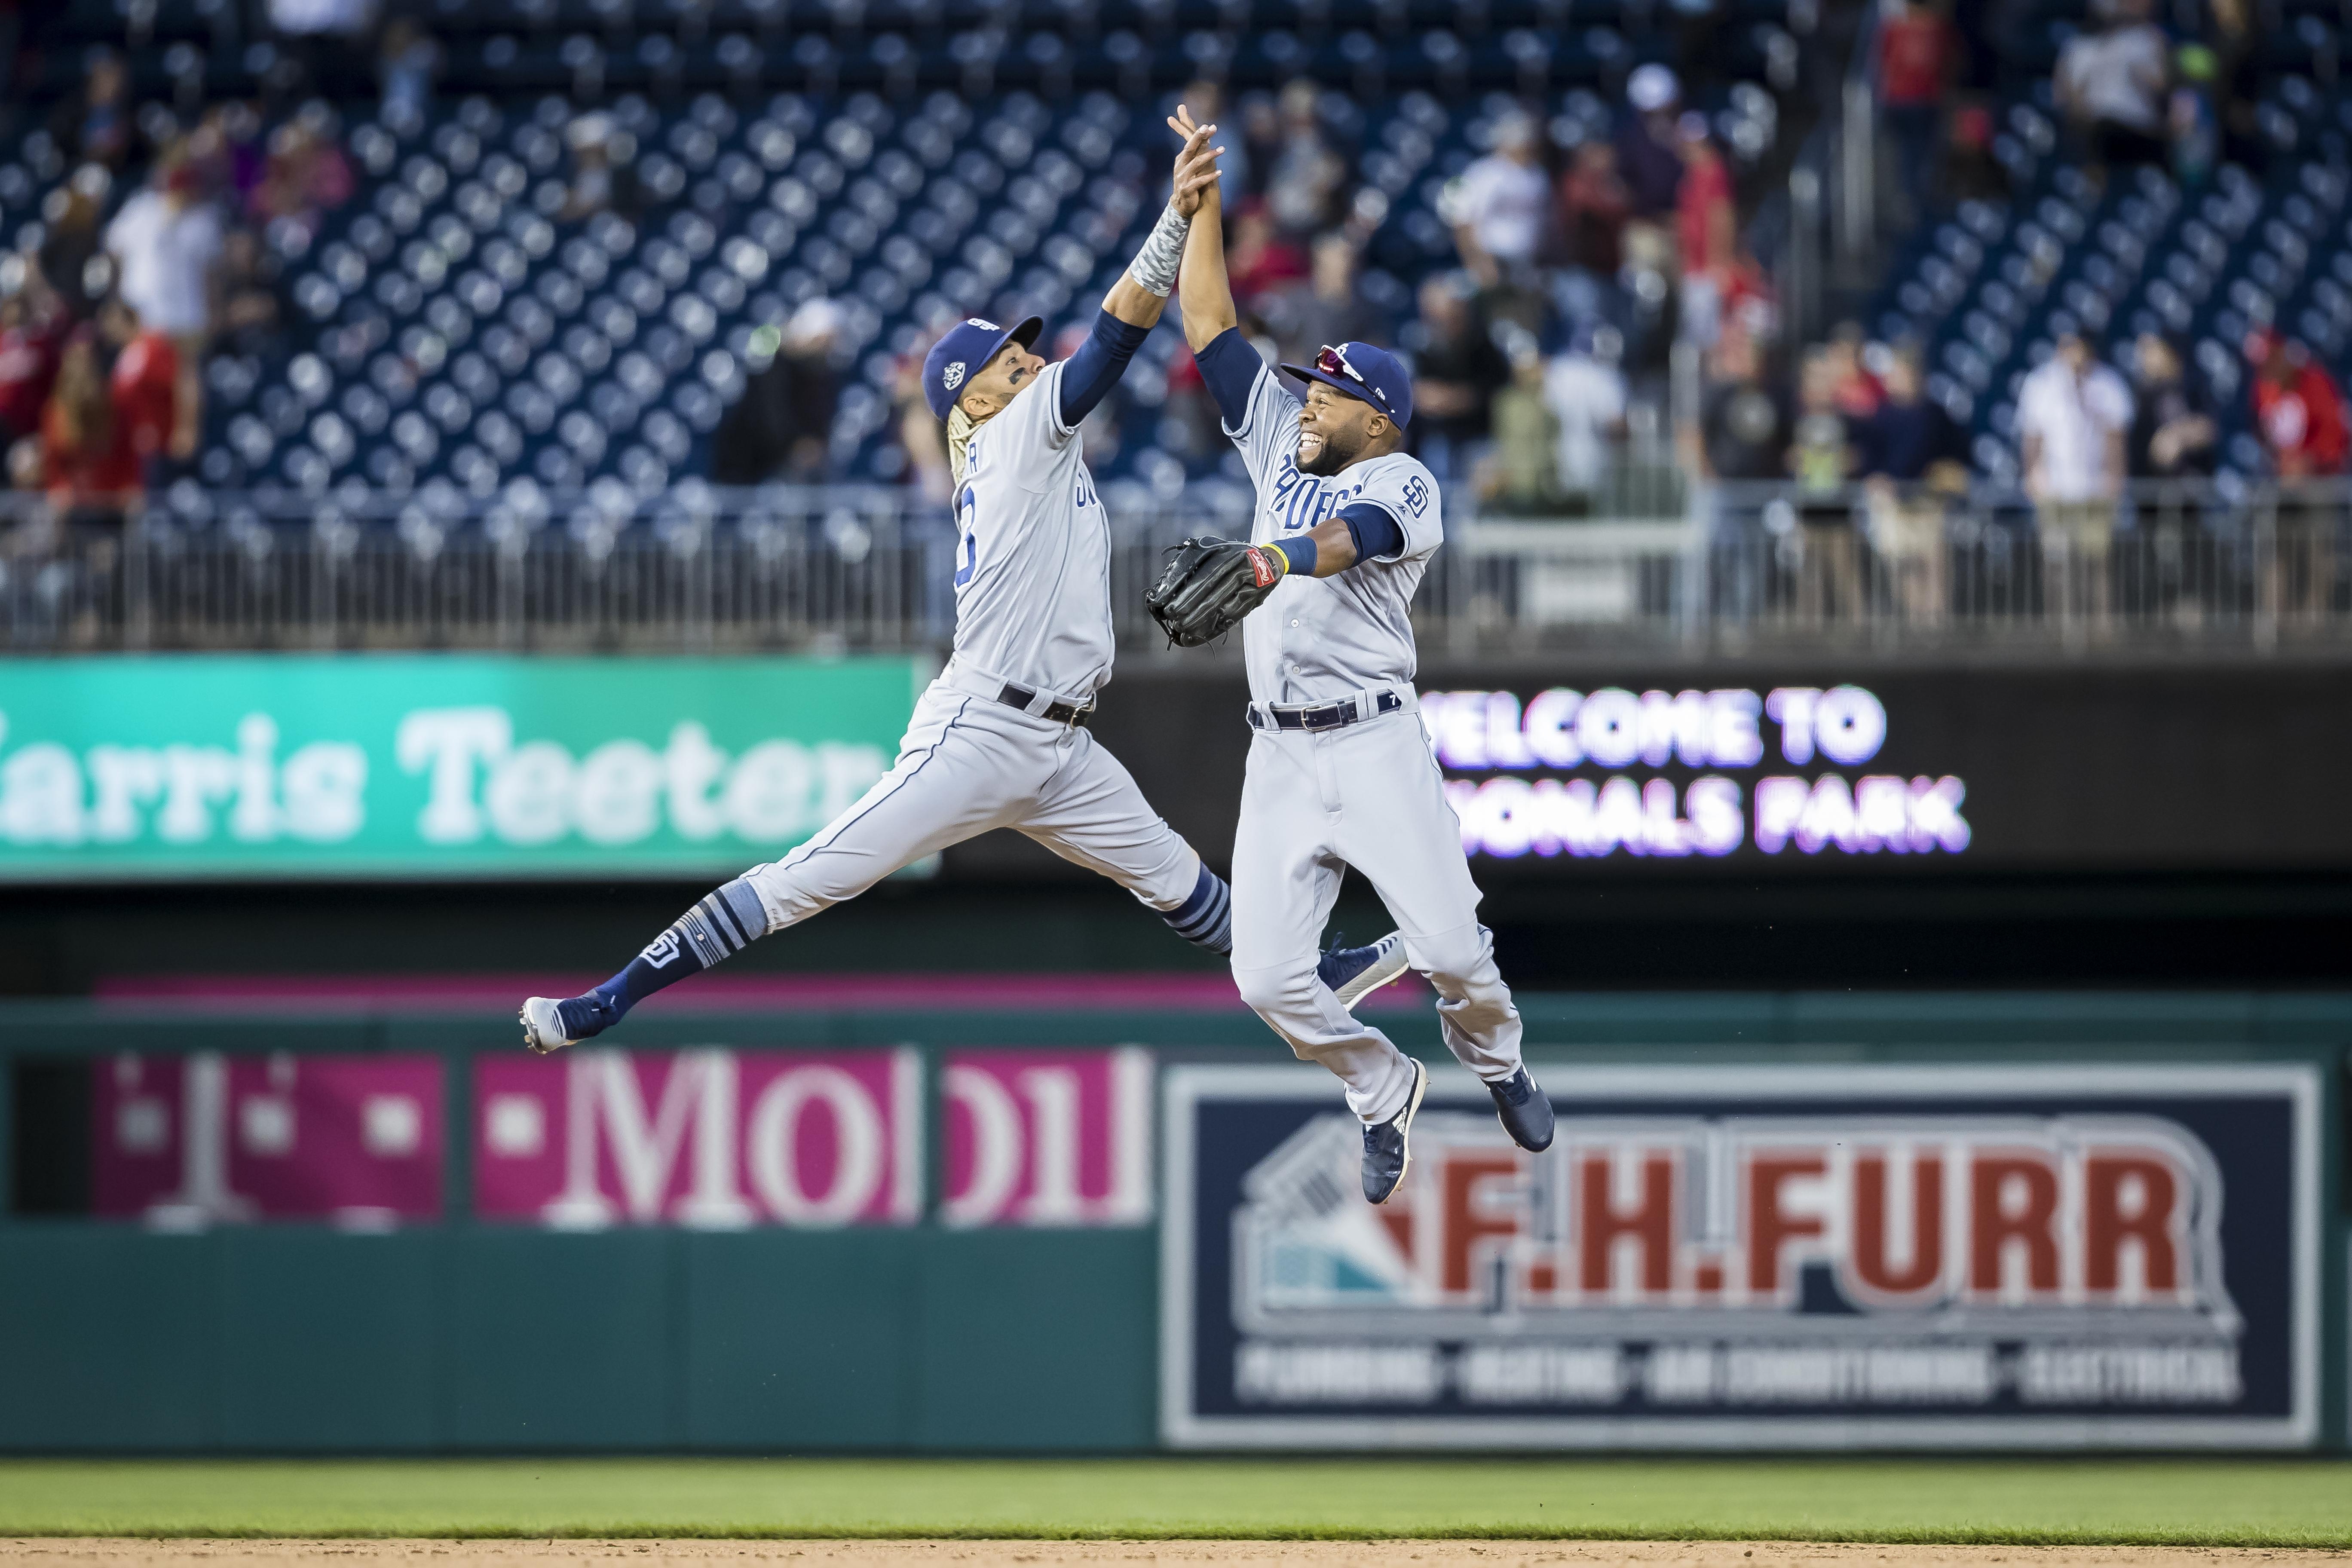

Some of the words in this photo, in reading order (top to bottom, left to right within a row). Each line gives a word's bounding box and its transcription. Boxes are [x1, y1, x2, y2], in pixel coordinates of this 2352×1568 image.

[1402, 475, 1429, 519] SD
[1389, 695, 1396, 706] 7
[1418, 690, 1763, 770] ELCOME
[1766, 686, 1886, 766] TO
[0, 714, 365, 842] arris
[398, 708, 885, 842] Teeter
[1443, 775, 1744, 858] IONALS
[1755, 773, 1971, 854] PARK
